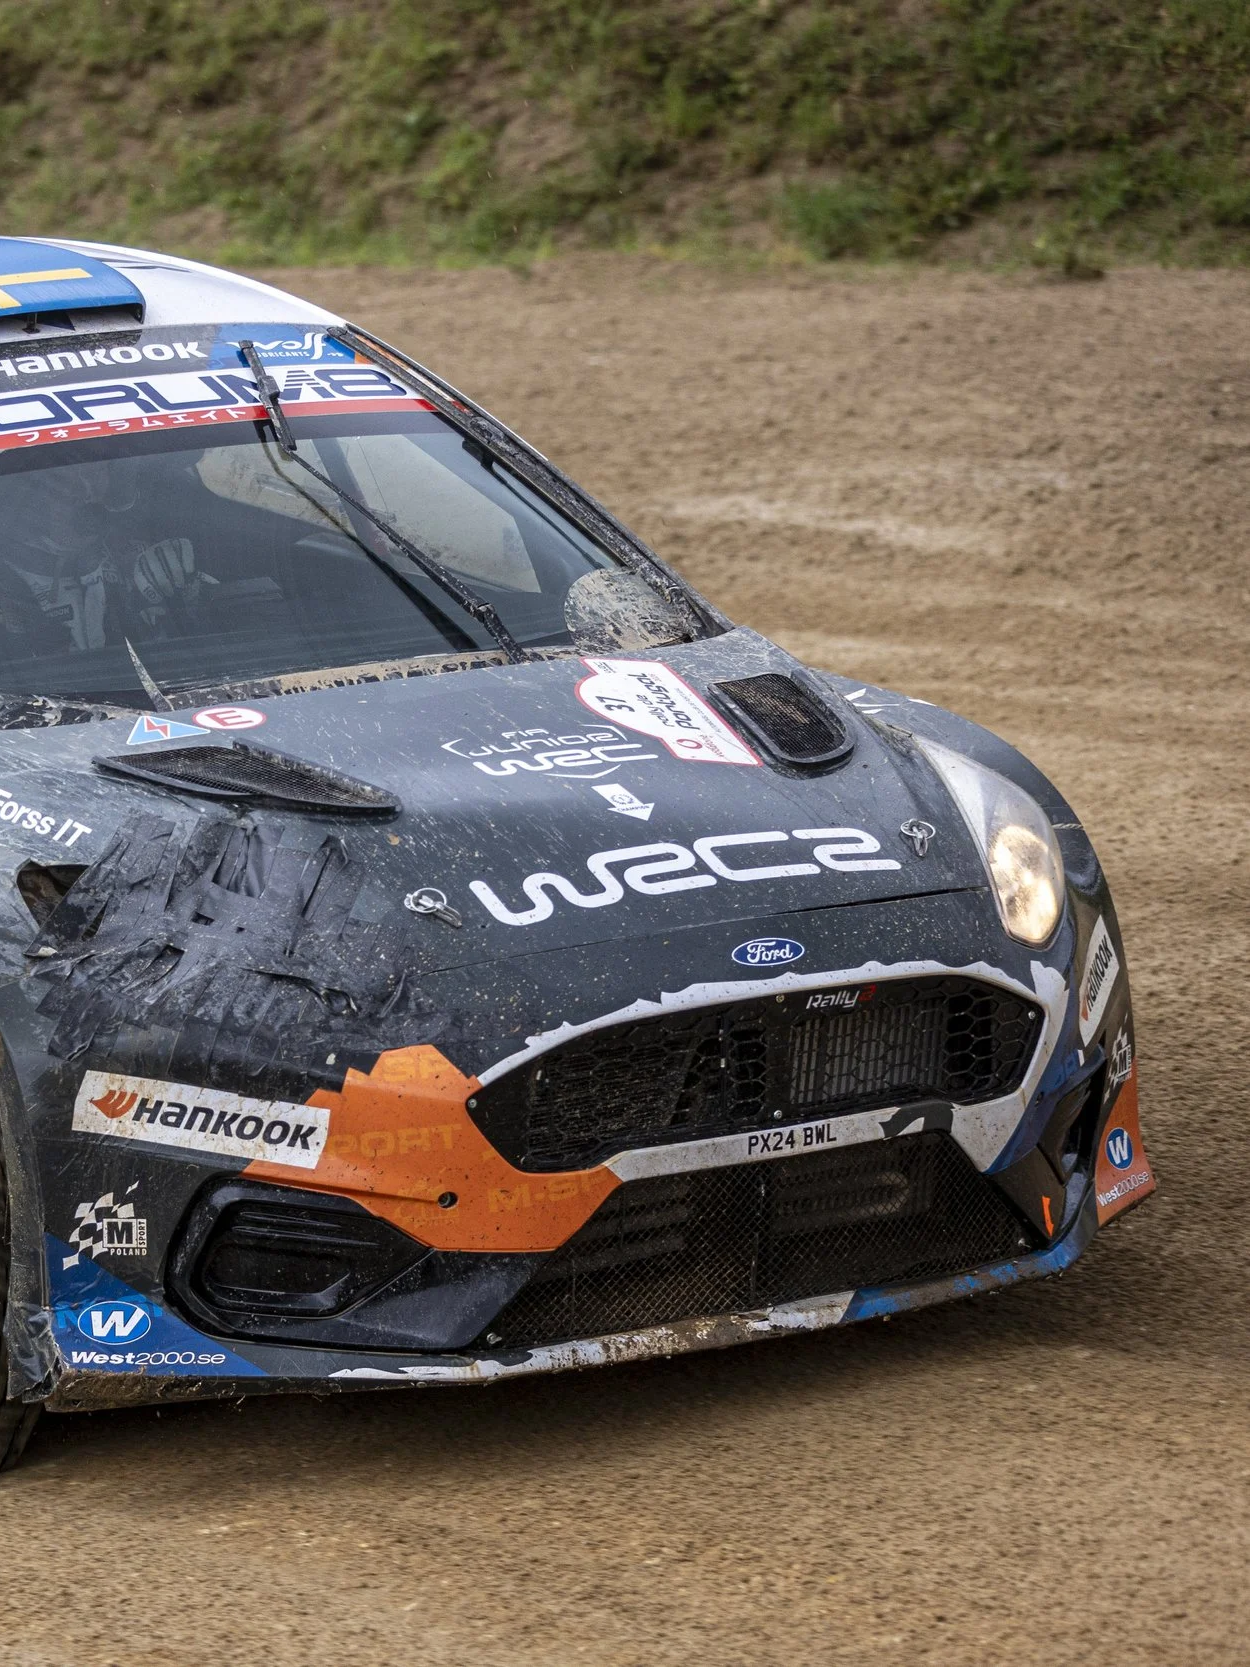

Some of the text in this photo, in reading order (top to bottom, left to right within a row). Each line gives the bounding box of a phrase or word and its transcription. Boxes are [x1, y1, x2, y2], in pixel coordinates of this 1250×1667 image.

[17, 405, 247, 443] フォーラムエイト
[595, 695, 636, 713] 37
[627, 673, 701, 730] Portugal
[469, 731, 619, 757] JUNIOR
[501, 728, 550, 740] FIA
[473, 743, 659, 776] WRC
[52, 818, 92, 848] IT
[469, 827, 902, 926] WRC2
[747, 941, 794, 963] Ford
[747, 1123, 837, 1155] PX24 BWL
[1108, 1131, 1129, 1165] W
[1097, 1170, 1150, 1207] West2000.se
[106, 1220, 146, 1246] M SPORT
[110, 1248, 148, 1256] POLAND
[90, 1308, 145, 1337] W
[70, 1351, 226, 1365] West2000.se
